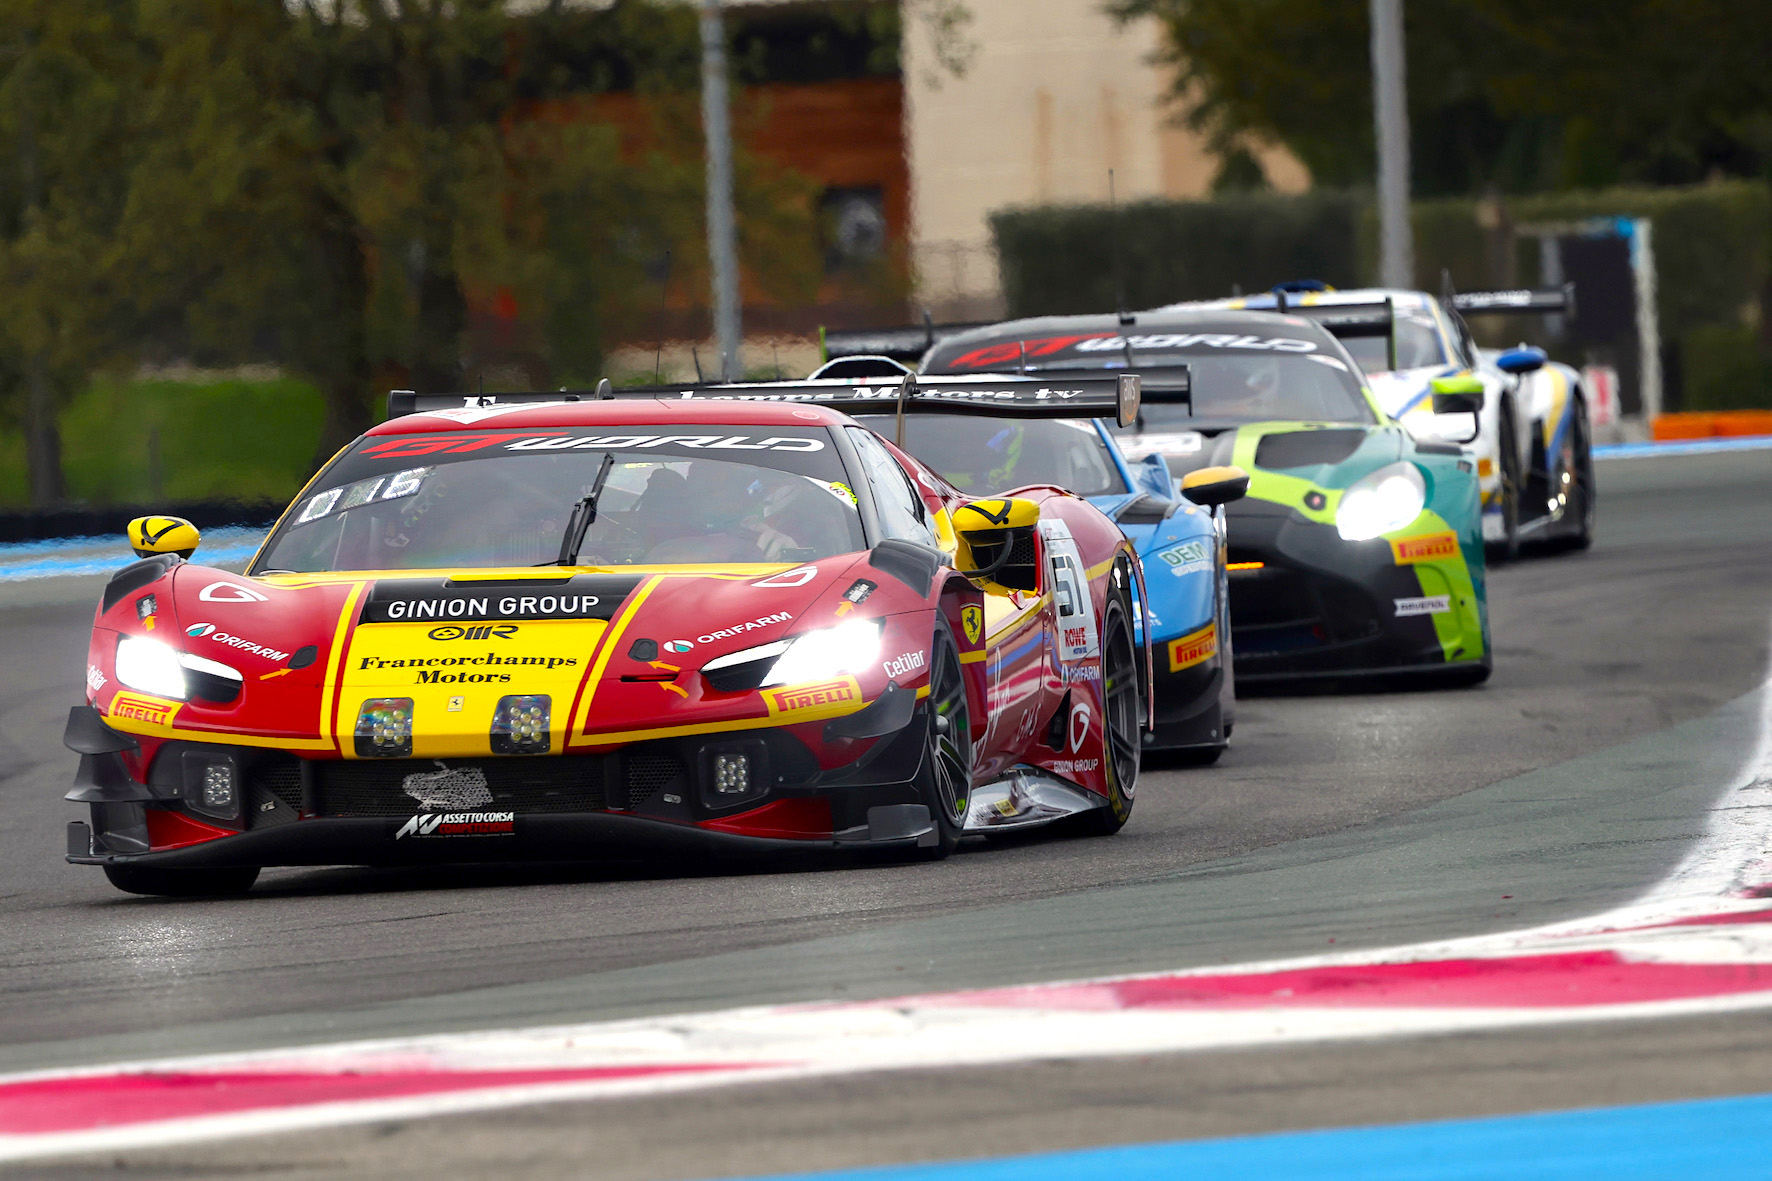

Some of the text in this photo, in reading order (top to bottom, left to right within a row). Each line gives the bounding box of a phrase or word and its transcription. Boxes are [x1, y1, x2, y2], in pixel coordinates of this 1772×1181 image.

[1075, 333, 1317, 353] WORLD
[360, 432, 826, 459] GT WORLD
[1398, 536, 1455, 559] PIRELLI
[1051, 554, 1086, 617] 51
[387, 595, 600, 619] GINION GROUP
[696, 611, 793, 644] ORIFARM
[1064, 627, 1087, 648] ROWE
[211, 632, 289, 662] ORIFARM
[358, 653, 578, 670] Francorchamps
[883, 650, 925, 679] Cetilar
[413, 670, 511, 685] Motors
[1070, 666, 1100, 683] ORIFARM
[772, 680, 854, 713] PIRELLI
[113, 697, 172, 726] PIRELLI
[1053, 758, 1099, 773] GINION GROUP
[439, 822, 514, 834] COMPETIZIONE
[442, 812, 514, 824] ASSETTO CORSA
